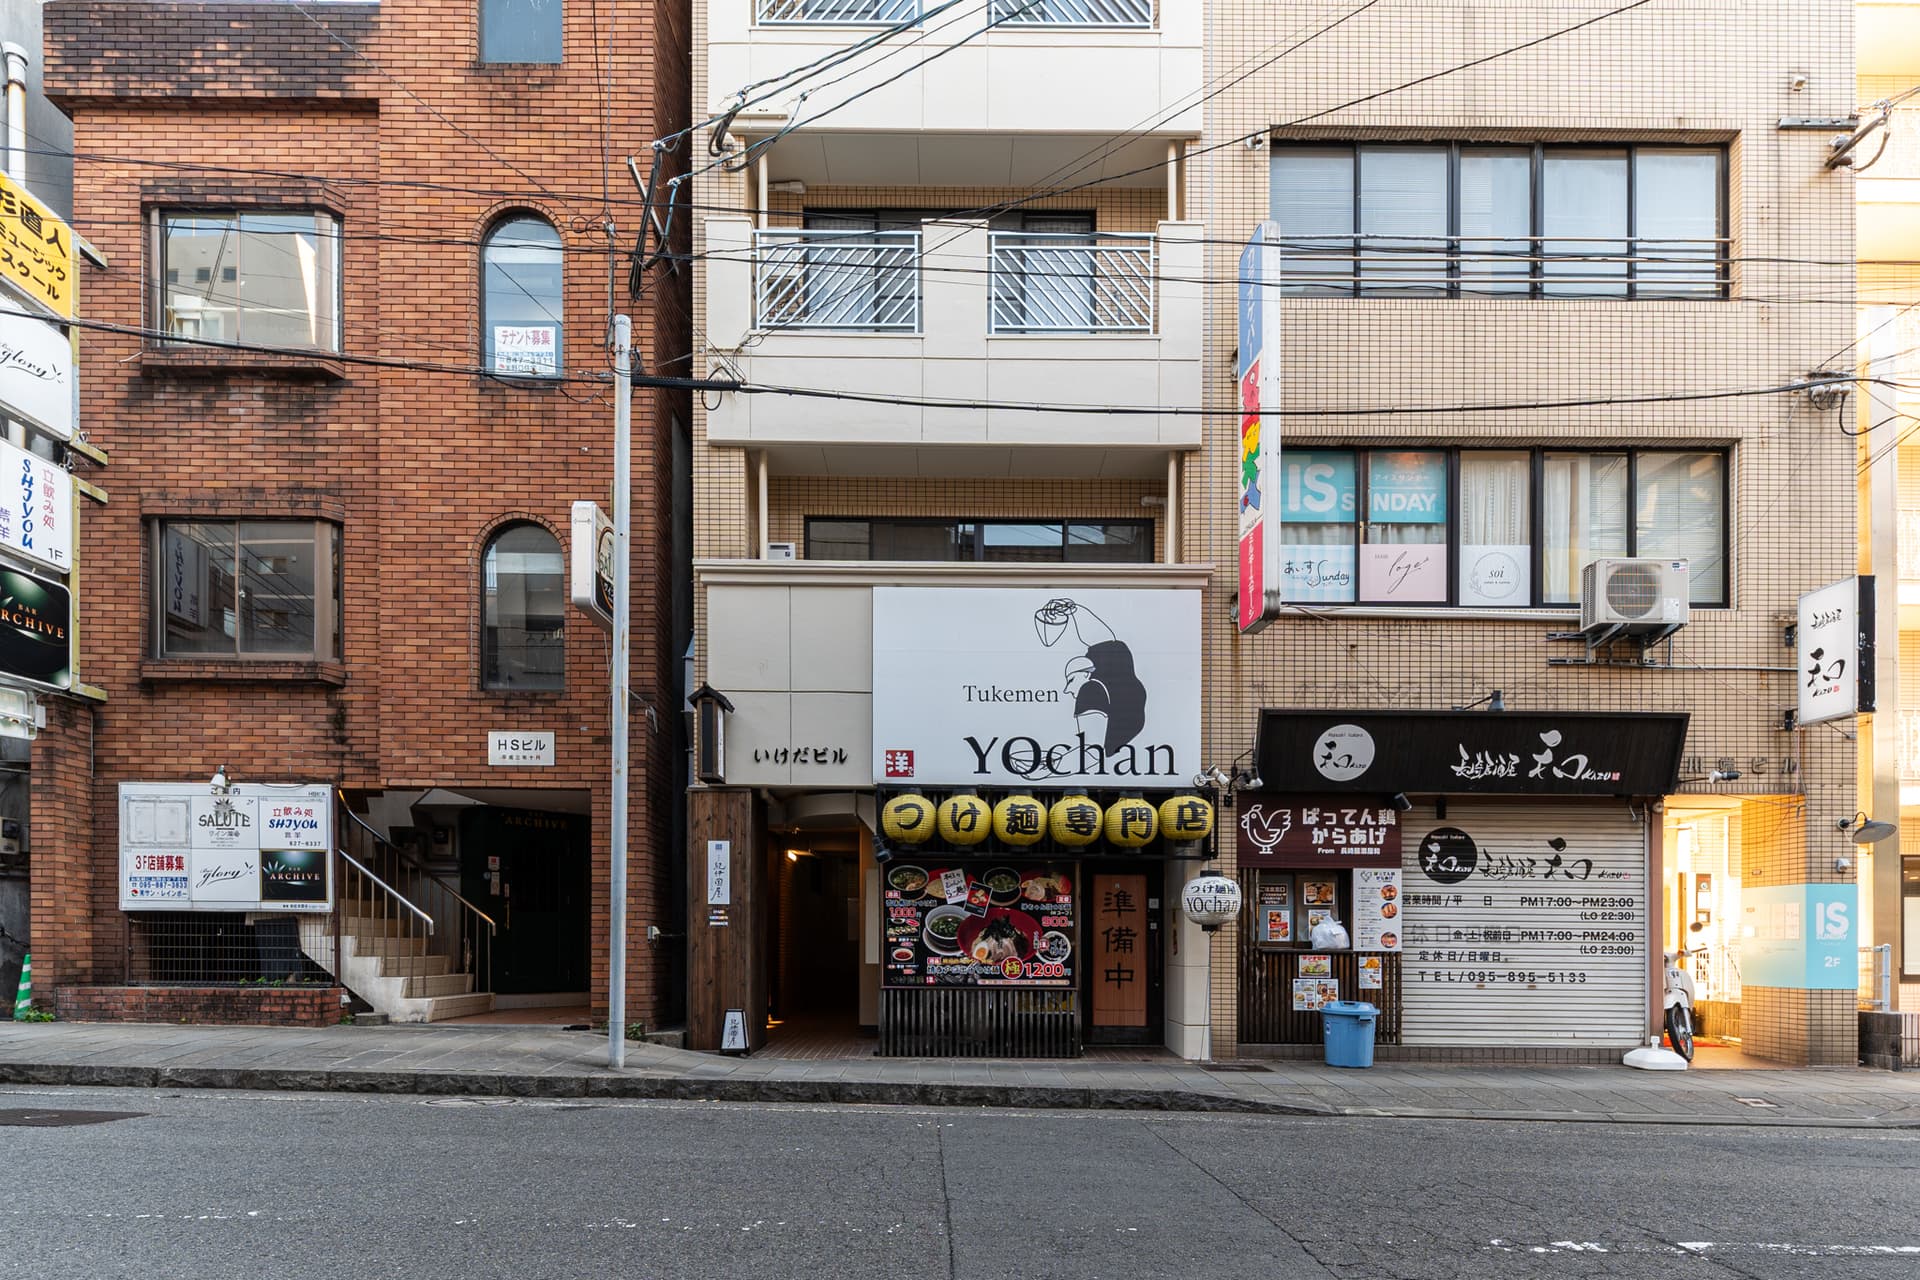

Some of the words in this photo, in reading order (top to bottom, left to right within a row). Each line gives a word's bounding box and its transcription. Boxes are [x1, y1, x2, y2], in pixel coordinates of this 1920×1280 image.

[1, 246, 60, 300] スクール
[501, 329, 551, 345] テナント募集
[1288, 463, 1338, 513] IS
[41, 468, 55, 530] 立飲み処
[48, 547, 63, 561] 1F
[1488, 566, 1505, 579] soi
[963, 684, 1059, 703] Tukemen
[497, 738, 546, 751] HSビル
[754, 747, 848, 765] いけだビル
[886, 751, 909, 774] 洋
[963, 732, 1178, 776] YOchan
[198, 809, 251, 827] SALUTE
[272, 806, 313, 817] 立飲み処
[1303, 808, 1396, 826] ばってん鶏
[1312, 828, 1385, 846] からあげ
[1317, 847, 1335, 855] From
[135, 855, 184, 871] 3F店舗募集
[1580, 911, 1598, 921] (LO
[1601, 911, 1635, 921] 22:30)
[1815, 902, 1849, 937] IS
[1102, 890, 1137, 990] 準備中
[1580, 945, 1598, 955] (LO
[1601, 945, 1634, 955] 23:00)
[1004, 960, 1022, 977] 極
[1824, 955, 1841, 968] 2F
